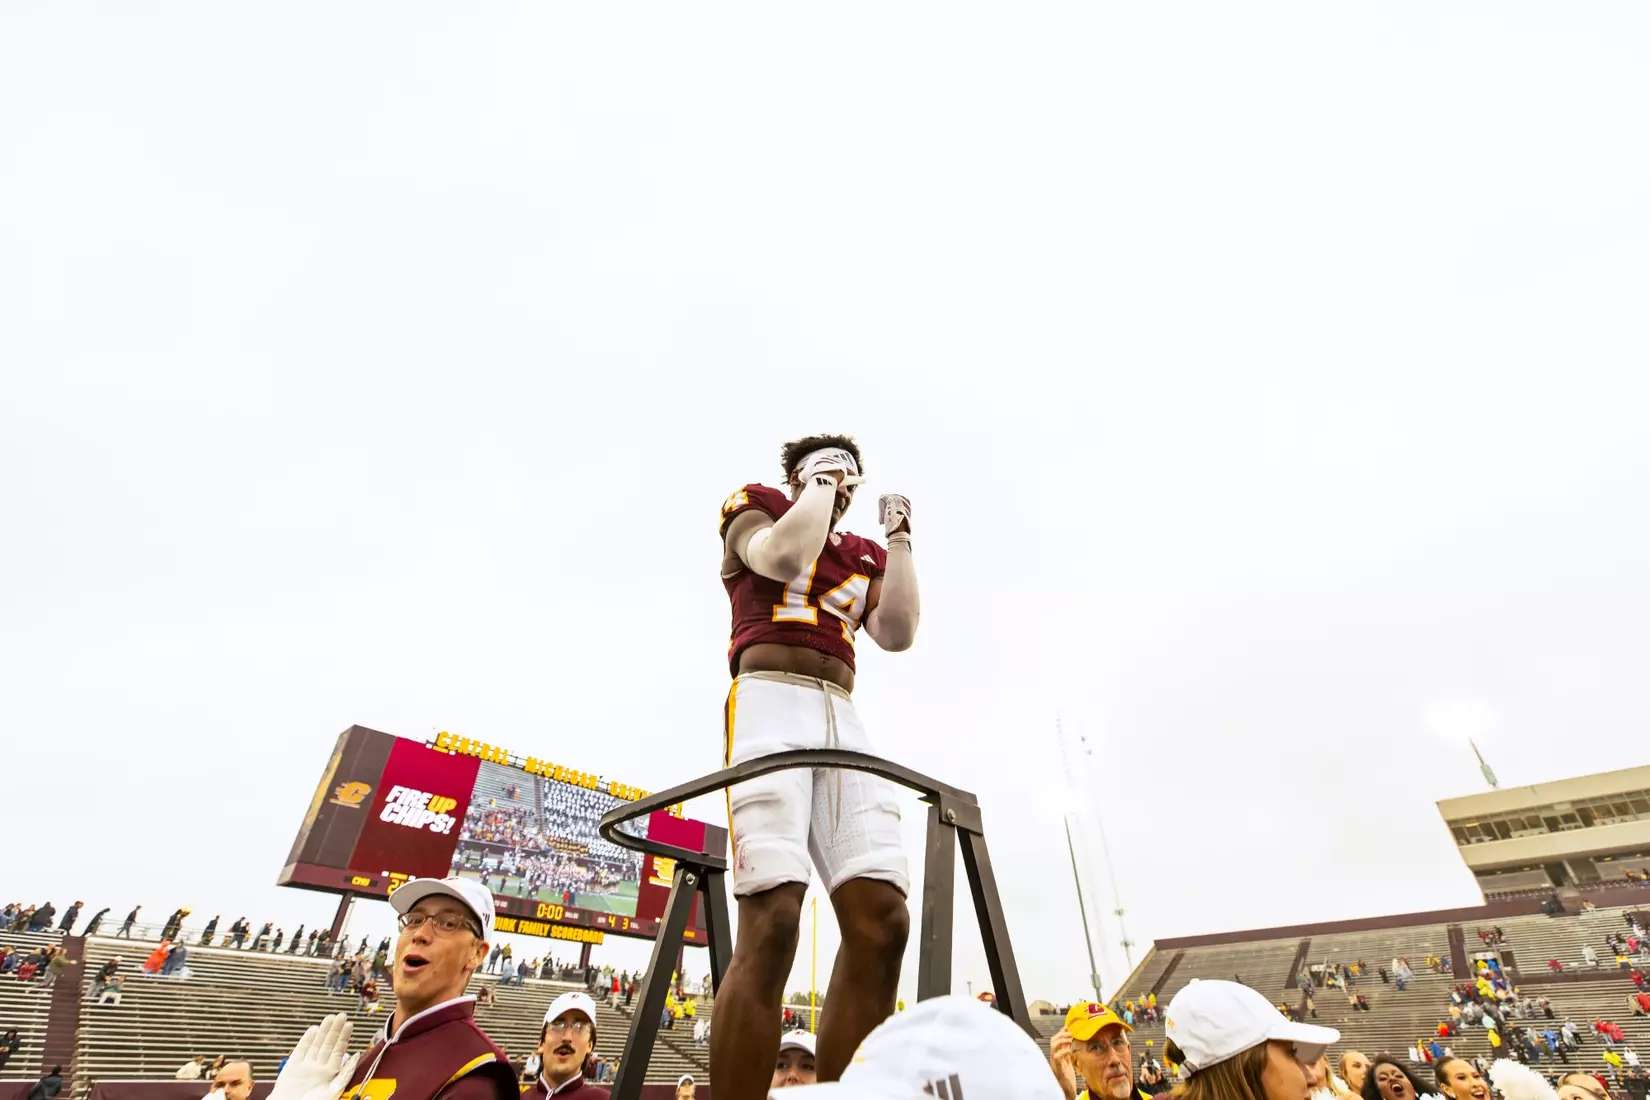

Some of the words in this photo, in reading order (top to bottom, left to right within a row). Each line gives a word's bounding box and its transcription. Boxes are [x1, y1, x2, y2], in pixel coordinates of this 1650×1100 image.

[772, 560, 870, 650] 14
[437, 731, 508, 766] CENTRAL
[524, 756, 597, 790] MICHIGAN
[385, 785, 433, 810] FIRE
[427, 795, 458, 814] UP
[380, 802, 456, 834] CHIPS!
[537, 903, 564, 921] 0:00
[518, 920, 550, 937] FAMILY
[550, 925, 605, 944] SCOREBOARD
